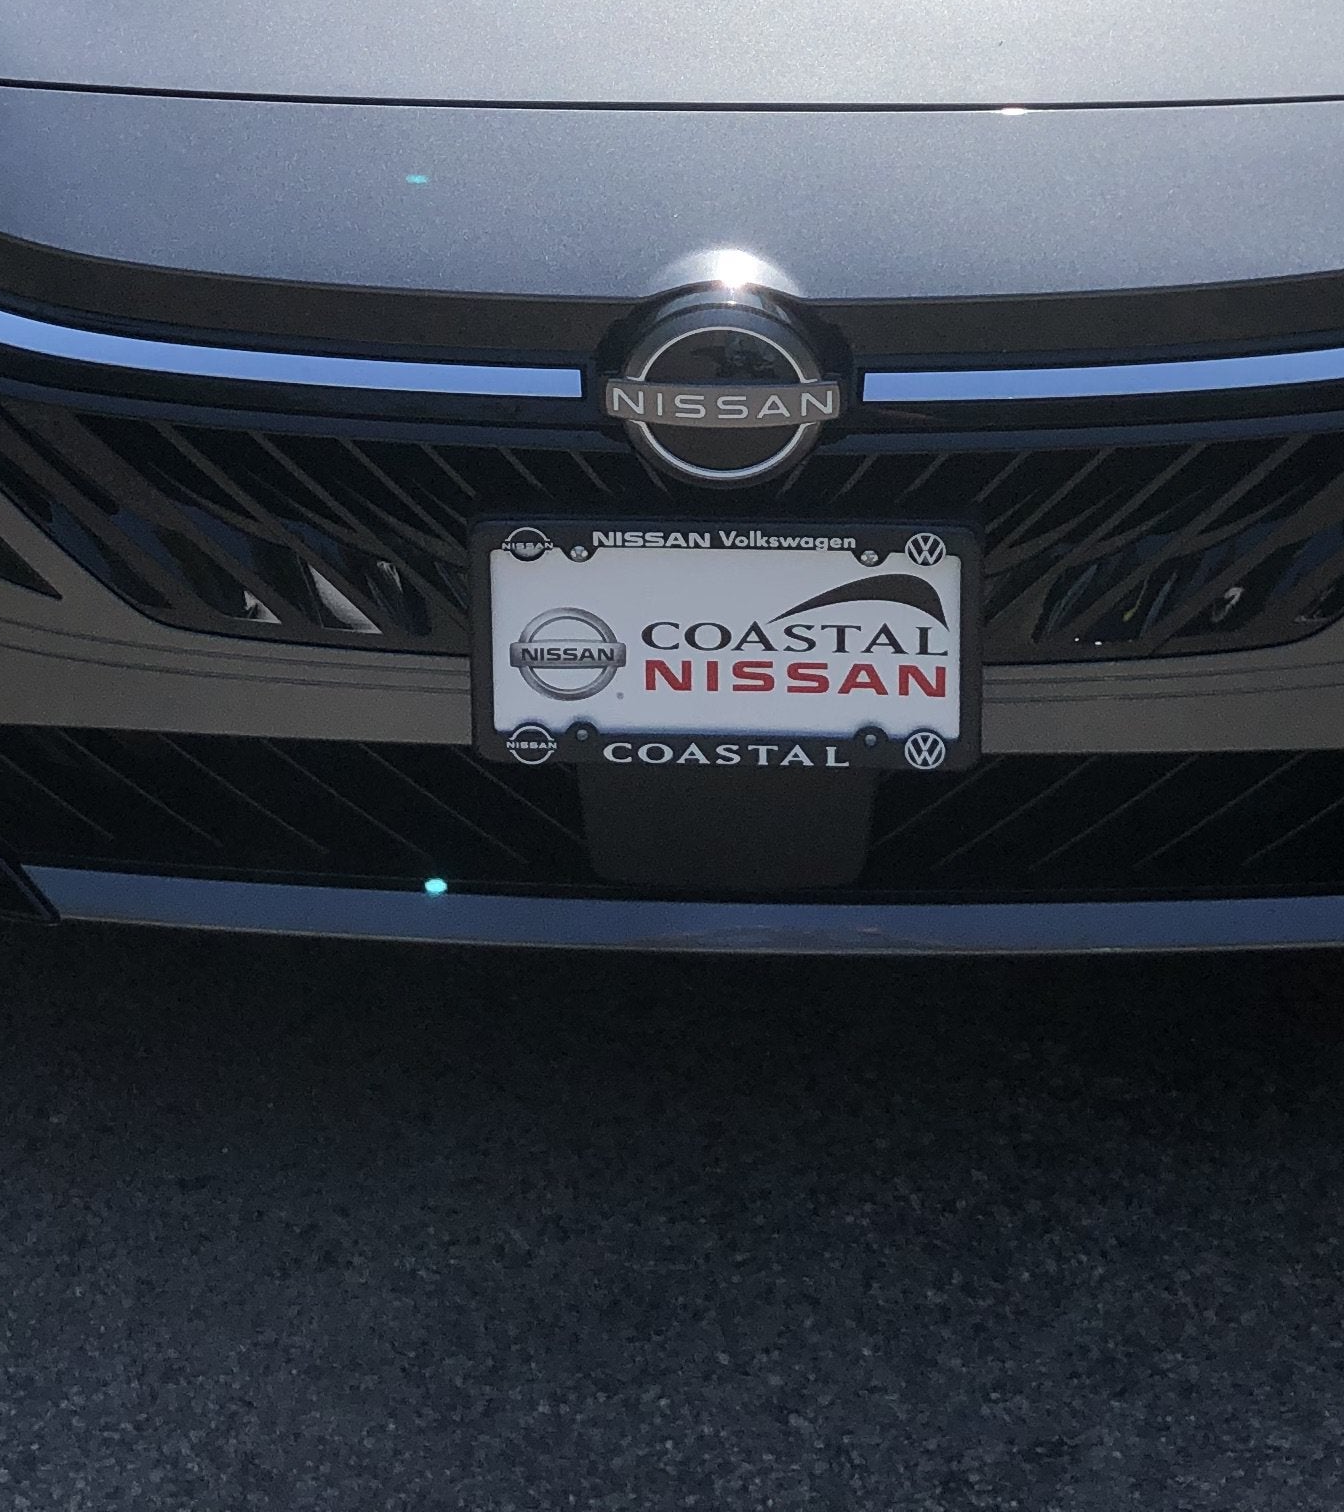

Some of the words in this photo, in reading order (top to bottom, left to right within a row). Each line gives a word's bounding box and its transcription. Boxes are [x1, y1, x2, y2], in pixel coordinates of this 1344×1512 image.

[612, 387, 833, 419] NISSAN
[501, 541, 554, 550] NISSAN
[592, 531, 711, 548] NISSAN
[718, 530, 856, 551] Volkswagen
[641, 620, 949, 656] COASTAL
[521, 647, 615, 662] NISSAN
[645, 659, 946, 698] NISSAN
[506, 741, 557, 749] NISSAN
[603, 741, 850, 767] COASTAL
